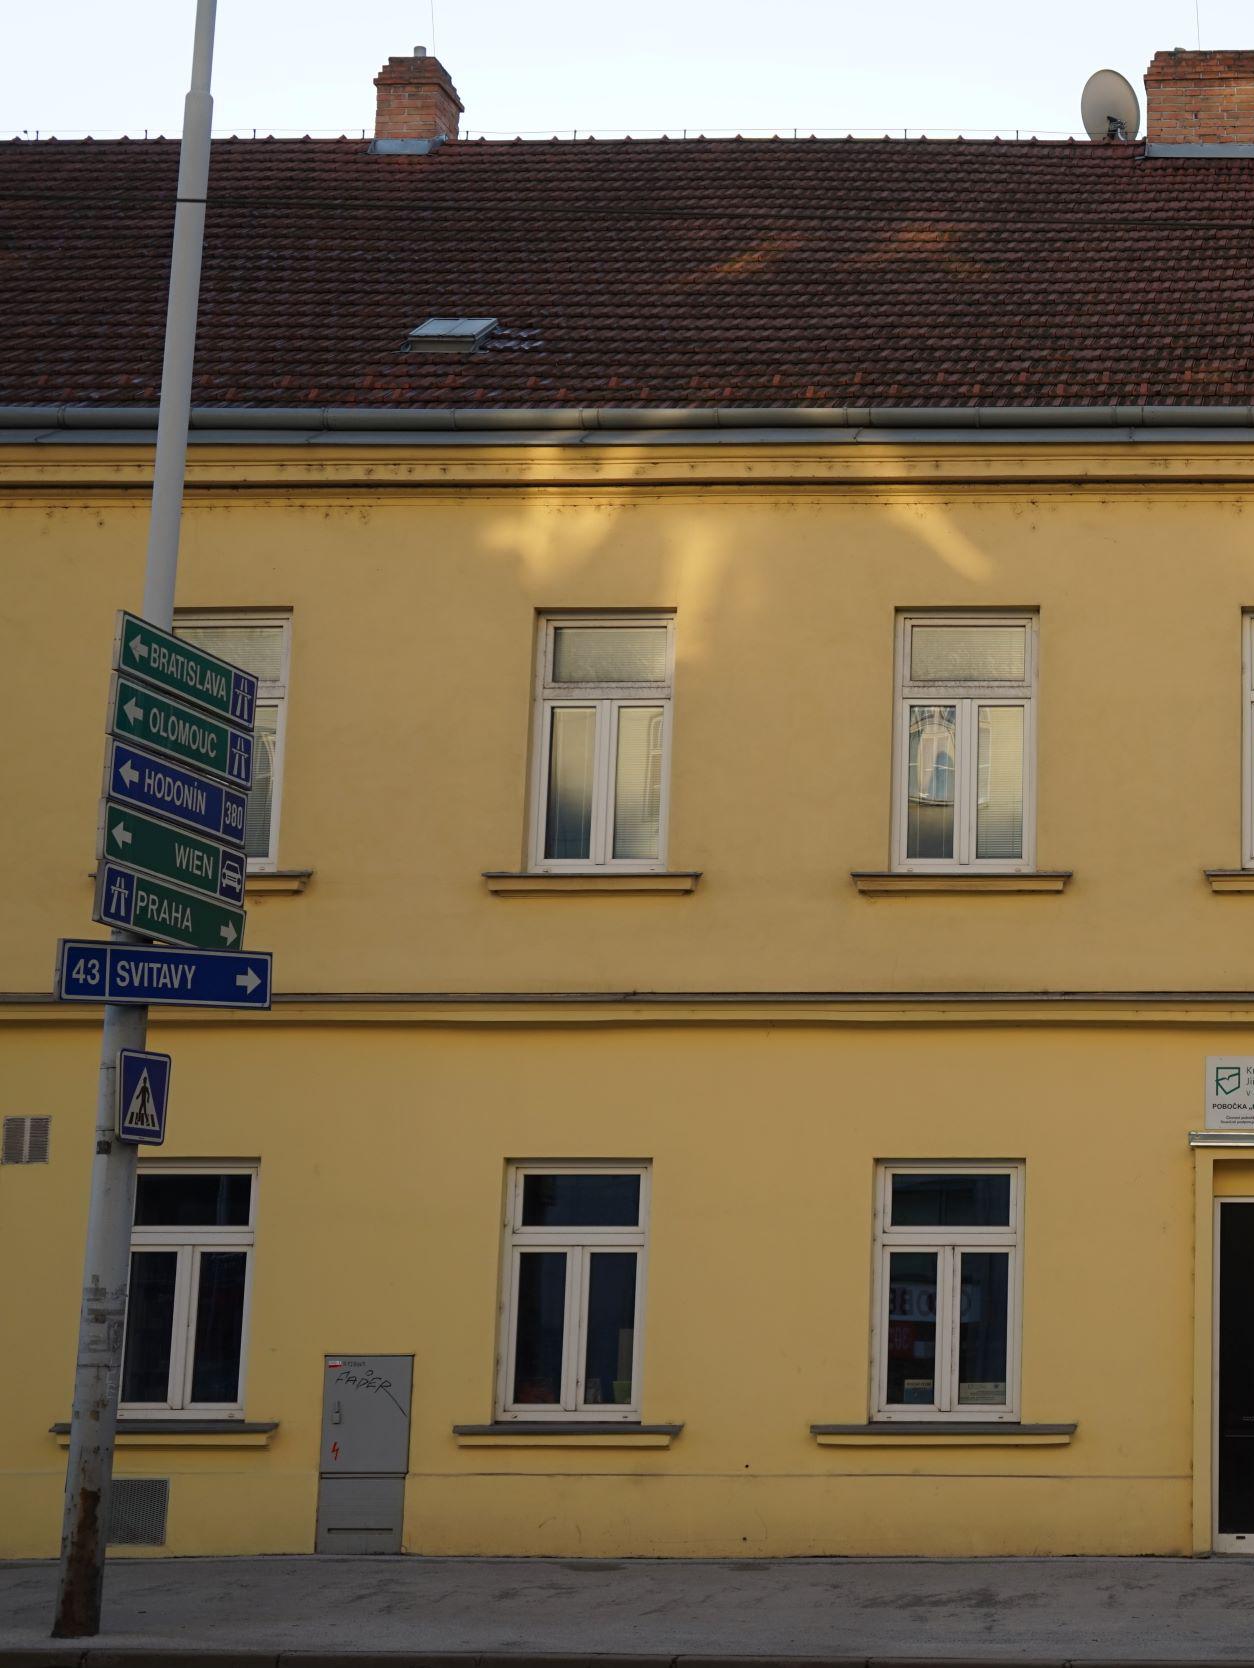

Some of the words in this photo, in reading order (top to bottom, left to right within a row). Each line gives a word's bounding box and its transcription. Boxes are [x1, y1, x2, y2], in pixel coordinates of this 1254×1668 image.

[150, 642, 227, 702] BRATISLAVA
[149, 707, 218, 758] OLOMOUC
[144, 768, 207, 815] HODONÍN
[225, 801, 244, 830] 380
[175, 842, 214, 880] WIEN
[136, 890, 193, 933] PRAHA
[71, 958, 100, 985] 43
[116, 960, 196, 990] SVITAVY
[1212, 1102, 1247, 1110] POBOČKA
